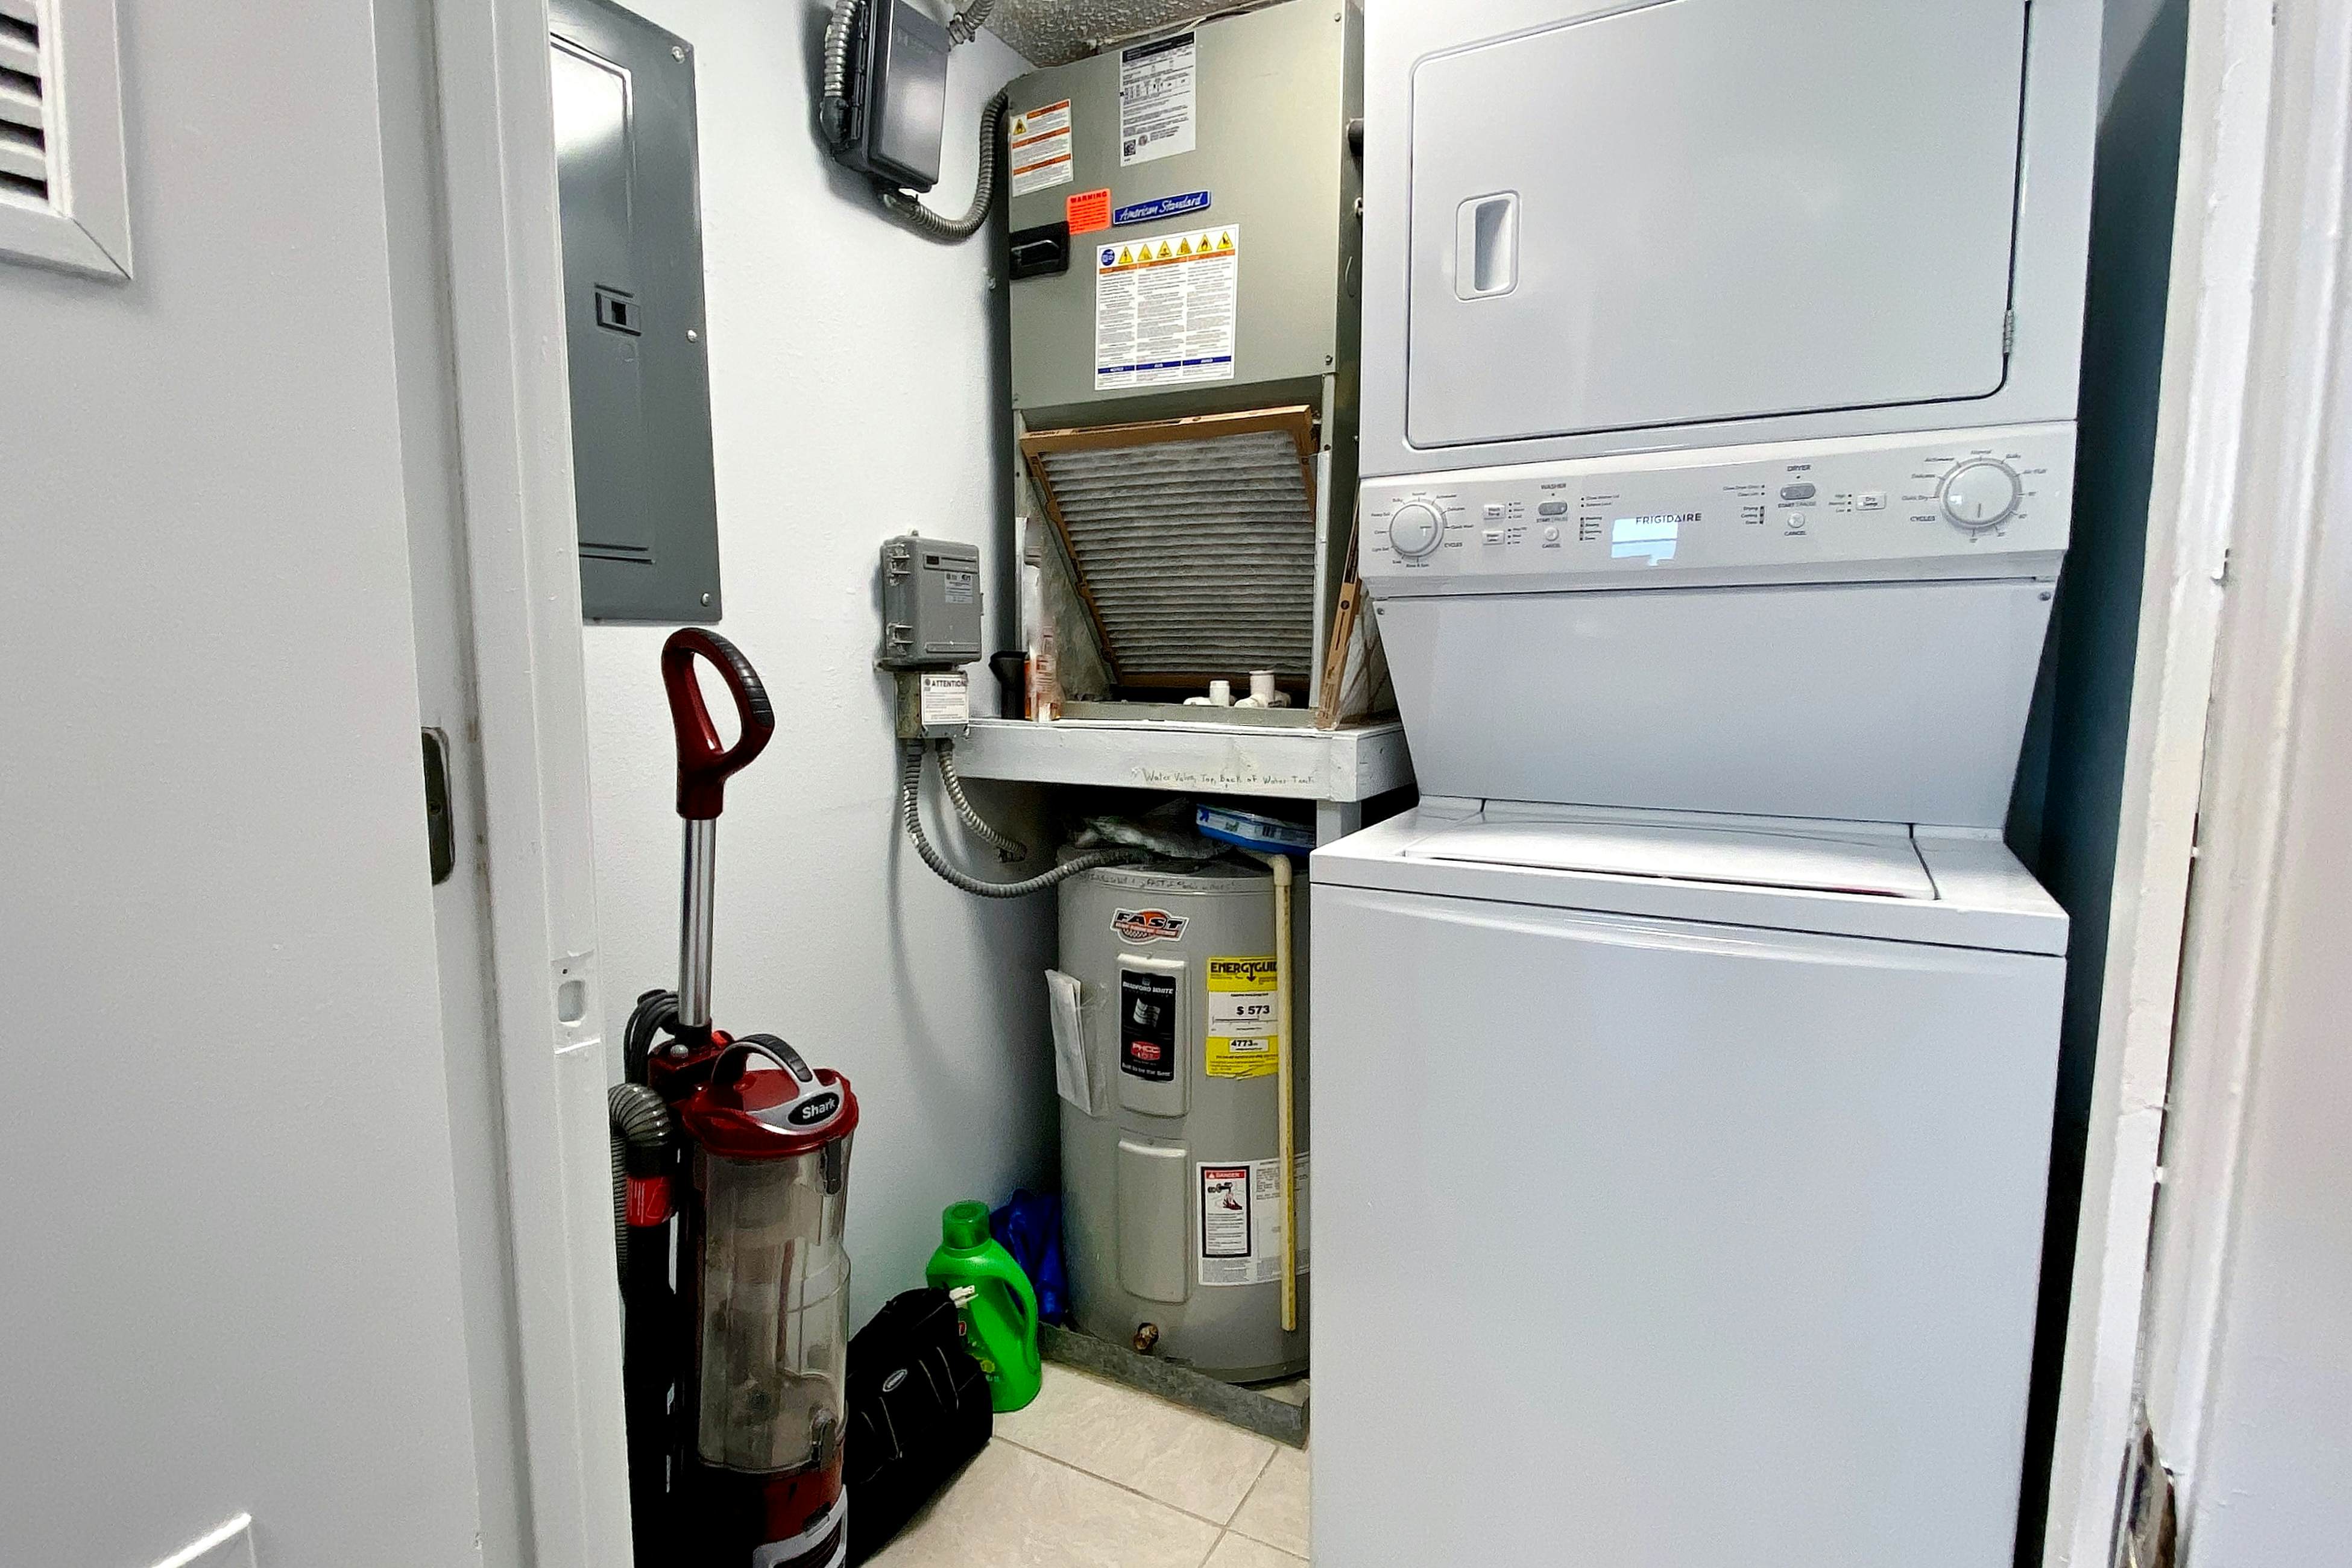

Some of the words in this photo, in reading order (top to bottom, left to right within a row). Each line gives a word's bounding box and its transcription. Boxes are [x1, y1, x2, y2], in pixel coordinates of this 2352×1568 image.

[1070, 190, 1108, 204] WARNING
[1119, 205, 1158, 221] American
[1159, 193, 1203, 213] Standard
[1635, 513, 1703, 525] FRIGIDAIRE
[1117, 912, 1183, 929] FAST
[1210, 961, 1277, 974] ENERGYGUI
[1236, 1006, 1244, 1016] $
[1248, 1004, 1270, 1016] 573
[802, 1098, 835, 1119] Shark
